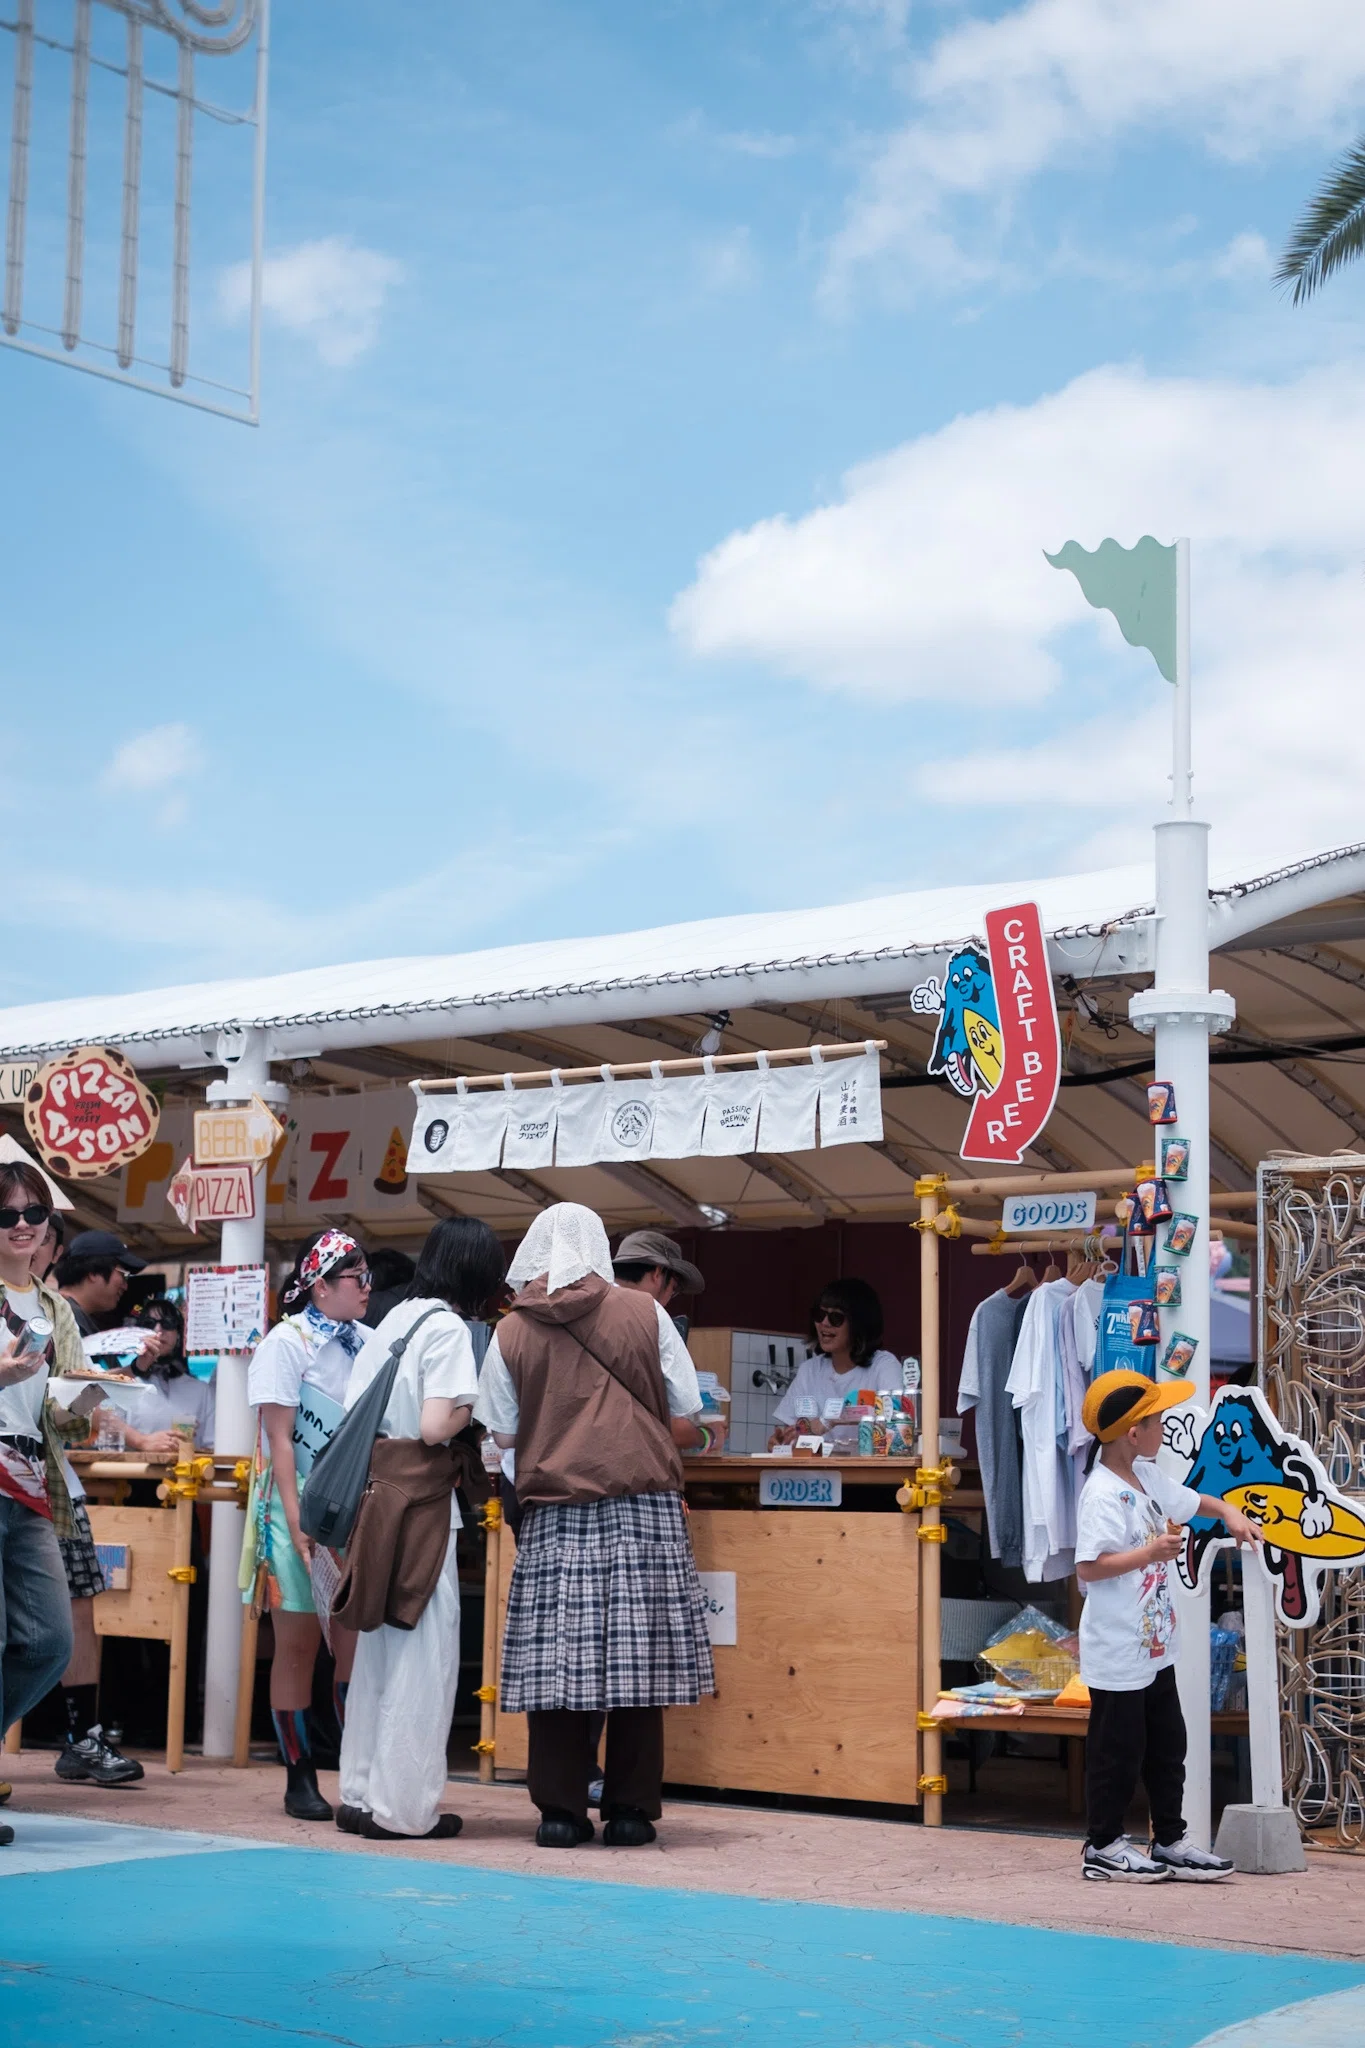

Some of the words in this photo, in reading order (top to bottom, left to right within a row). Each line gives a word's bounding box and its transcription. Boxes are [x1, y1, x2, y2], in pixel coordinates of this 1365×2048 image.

[1003, 918, 1037, 1042] CRAFT
[48, 1062, 138, 1114] PIZZA
[986, 1051, 1043, 1144] BEER
[721, 1105, 752, 1117] PASSIFIC
[45, 1109, 145, 1161] TYSON
[199, 1119, 247, 1158] BEER
[195, 1176, 249, 1217] PIZZA
[1010, 1200, 1087, 1227] GOODS
[767, 1478, 832, 1502] ORDER
